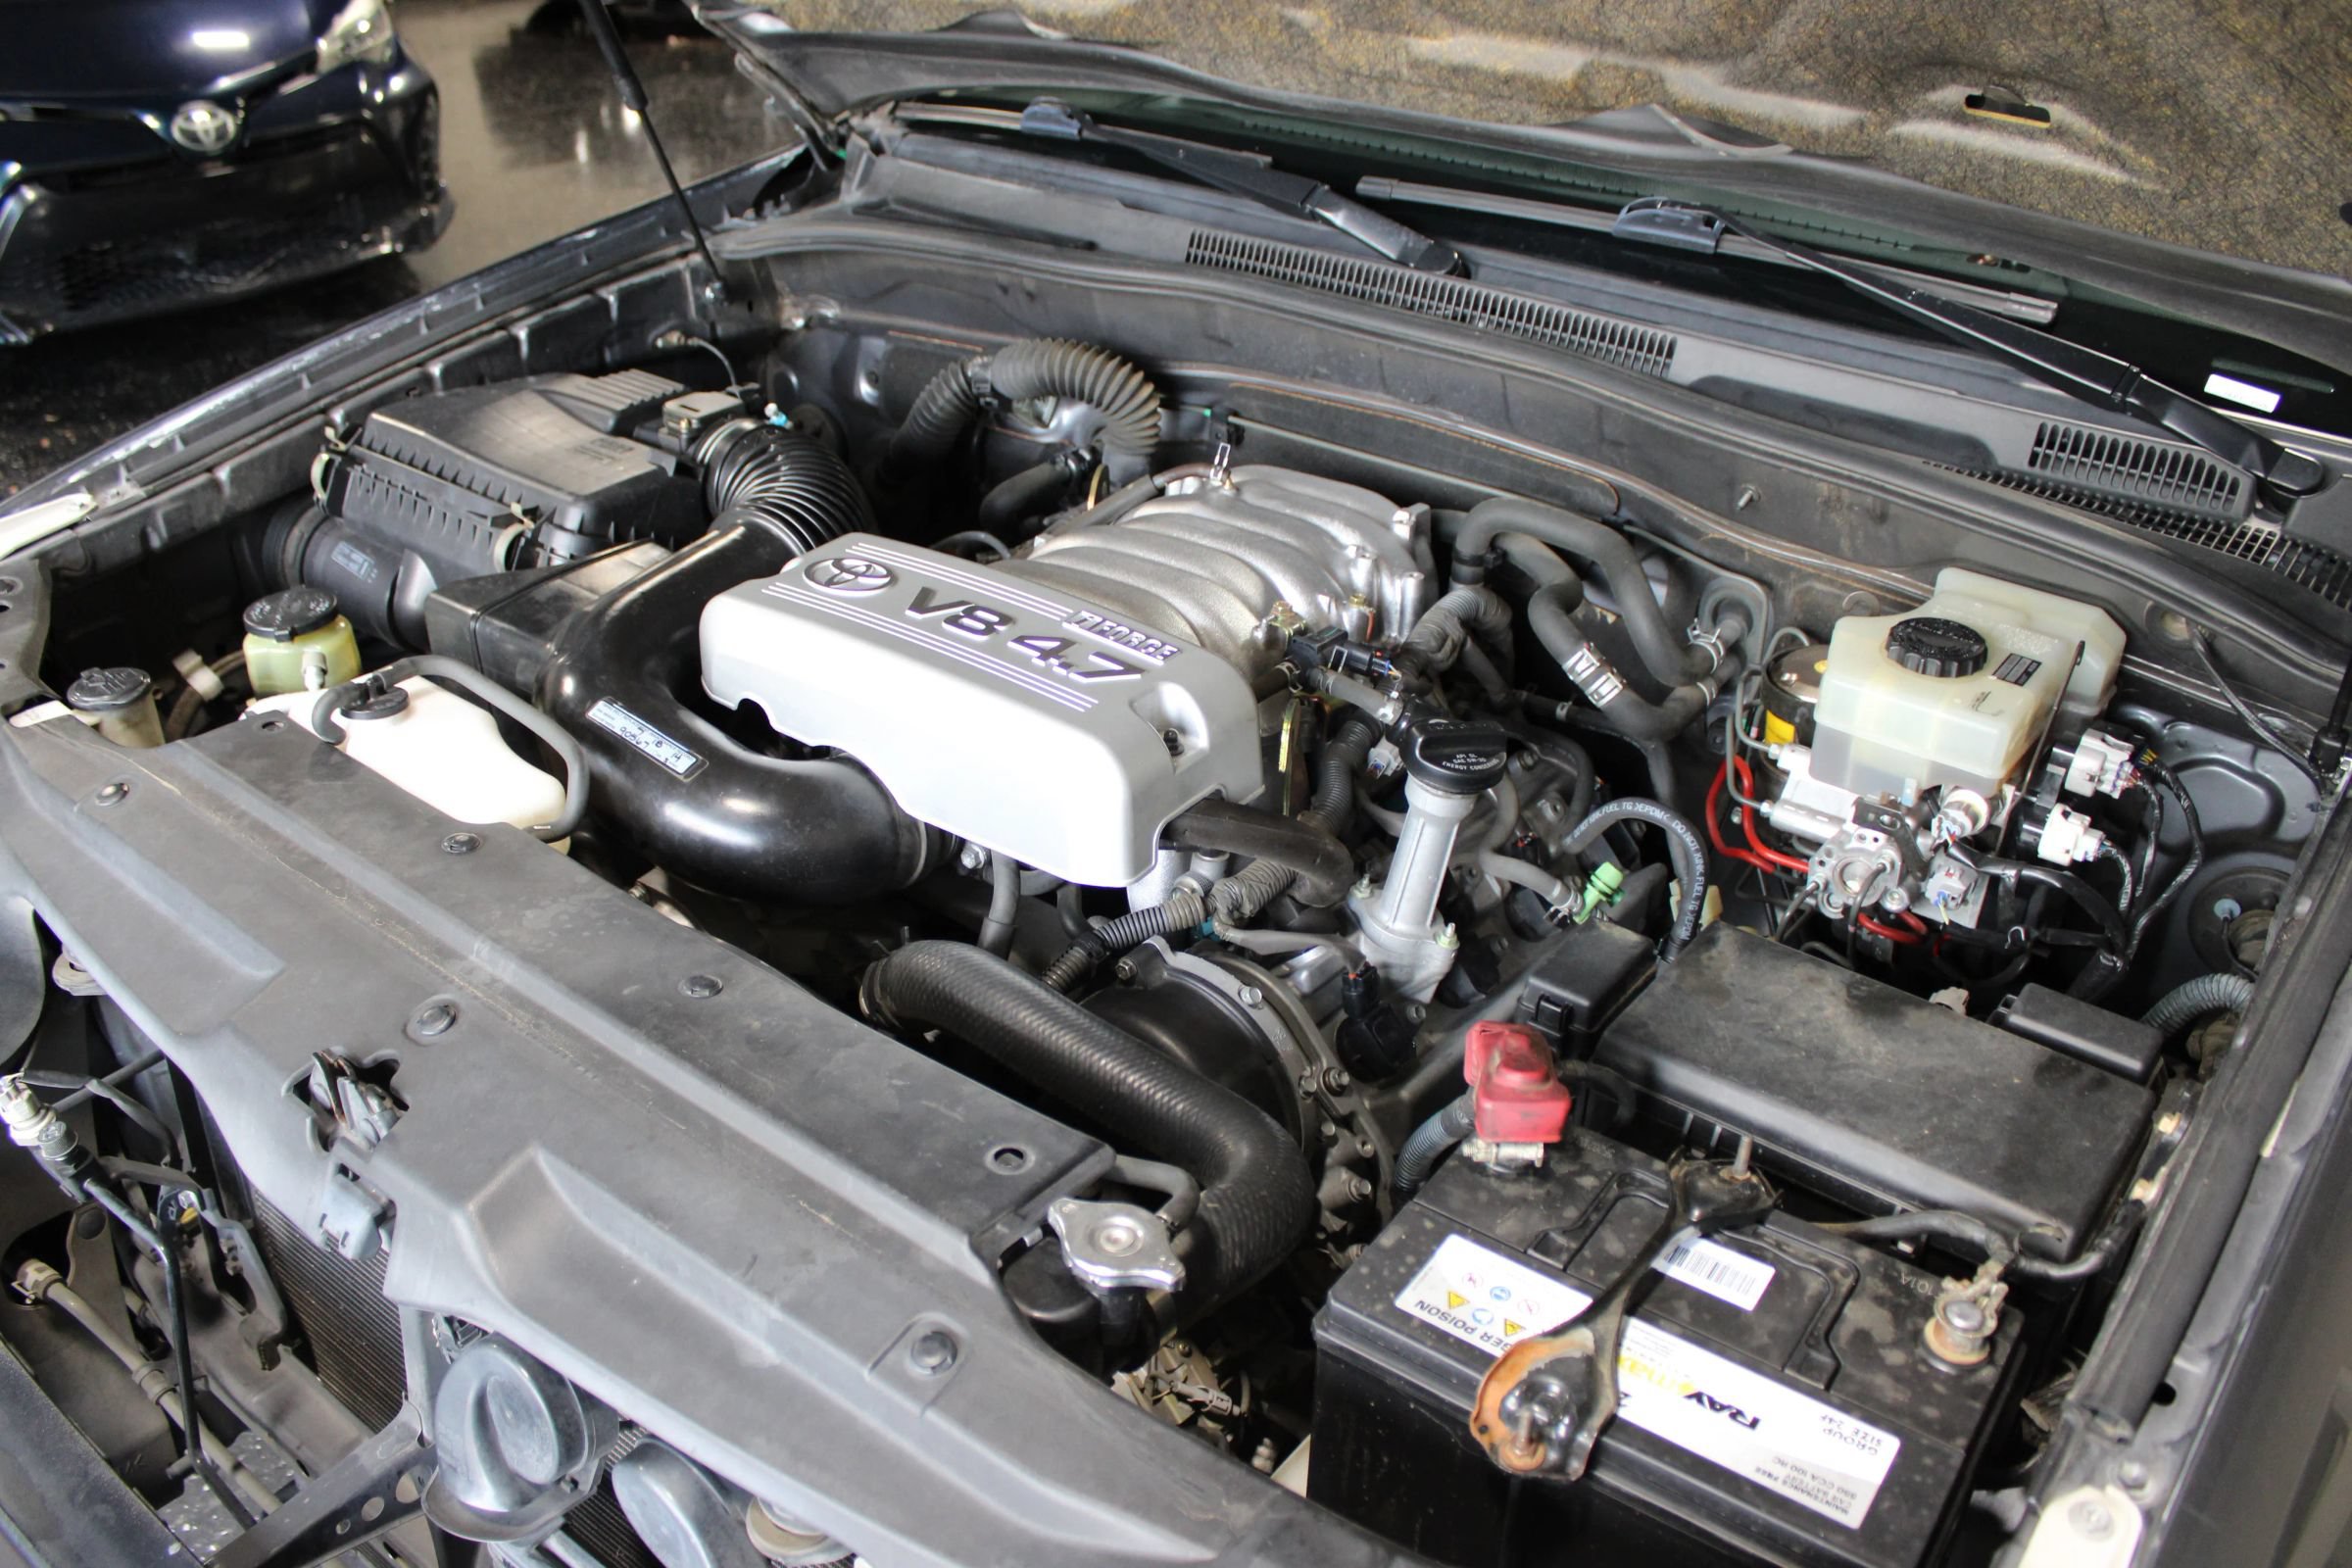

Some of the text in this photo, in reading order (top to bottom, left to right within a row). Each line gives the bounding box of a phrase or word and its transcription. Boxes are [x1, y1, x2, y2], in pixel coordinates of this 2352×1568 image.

[905, 586, 1148, 683] V8 4.7
[1442, 761, 1468, 770] ENERGY
[1622, 802, 1634, 810] TG
[1672, 819, 1687, 834] DO
[1683, 831, 1700, 852] NOT
[1691, 876, 1705, 898] FUEL
[1414, 1299, 1479, 1335] POISON
[1823, 1428, 1879, 1456] GROUP
[1852, 1427, 1883, 1447] SIZE
[1789, 1464, 1808, 1477] 100
[1810, 1473, 1836, 1490] CCA
